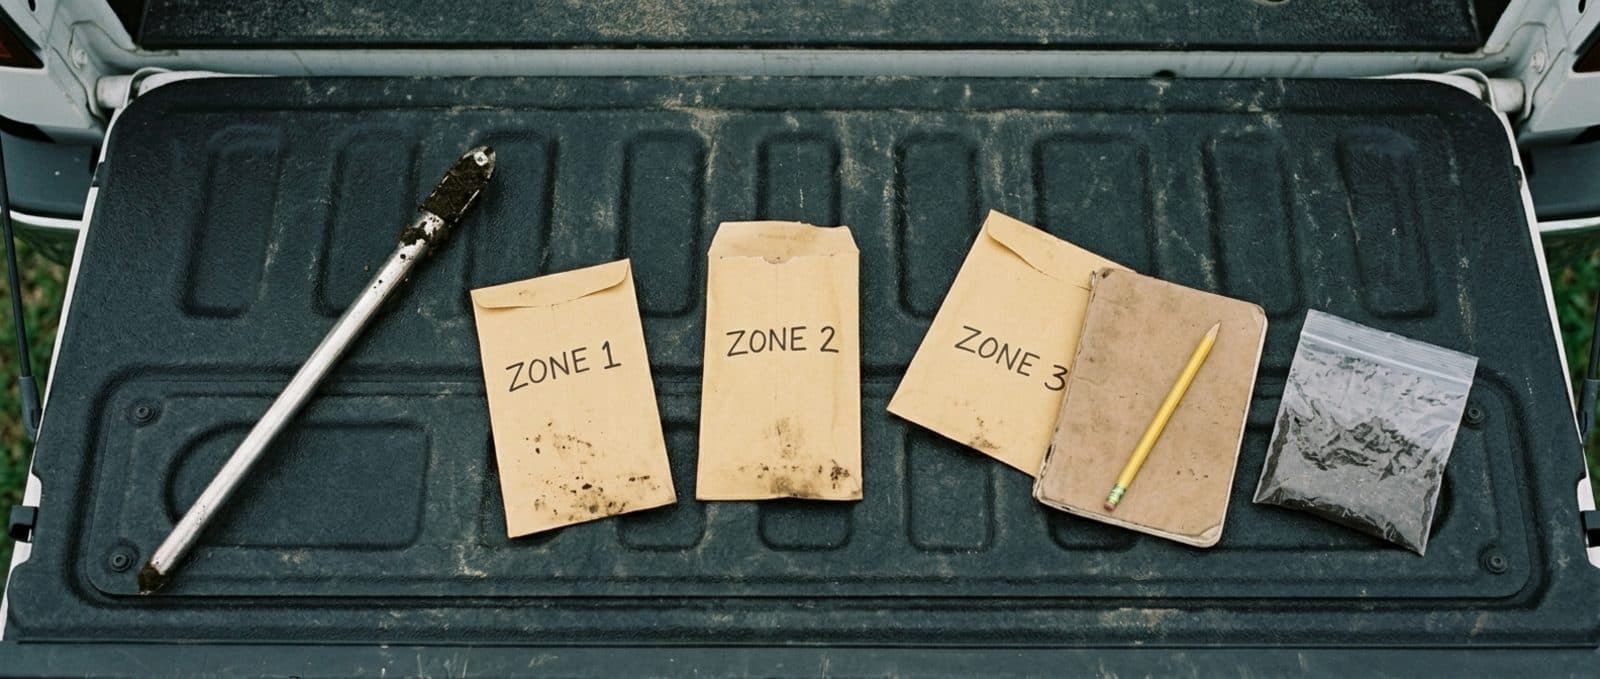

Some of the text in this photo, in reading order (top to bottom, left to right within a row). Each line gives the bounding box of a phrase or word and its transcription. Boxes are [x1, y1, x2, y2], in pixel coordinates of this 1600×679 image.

[505, 340, 622, 393] ZONE 1
[726, 326, 840, 357] ZONE 2
[954, 325, 1068, 391] ZONE 3
